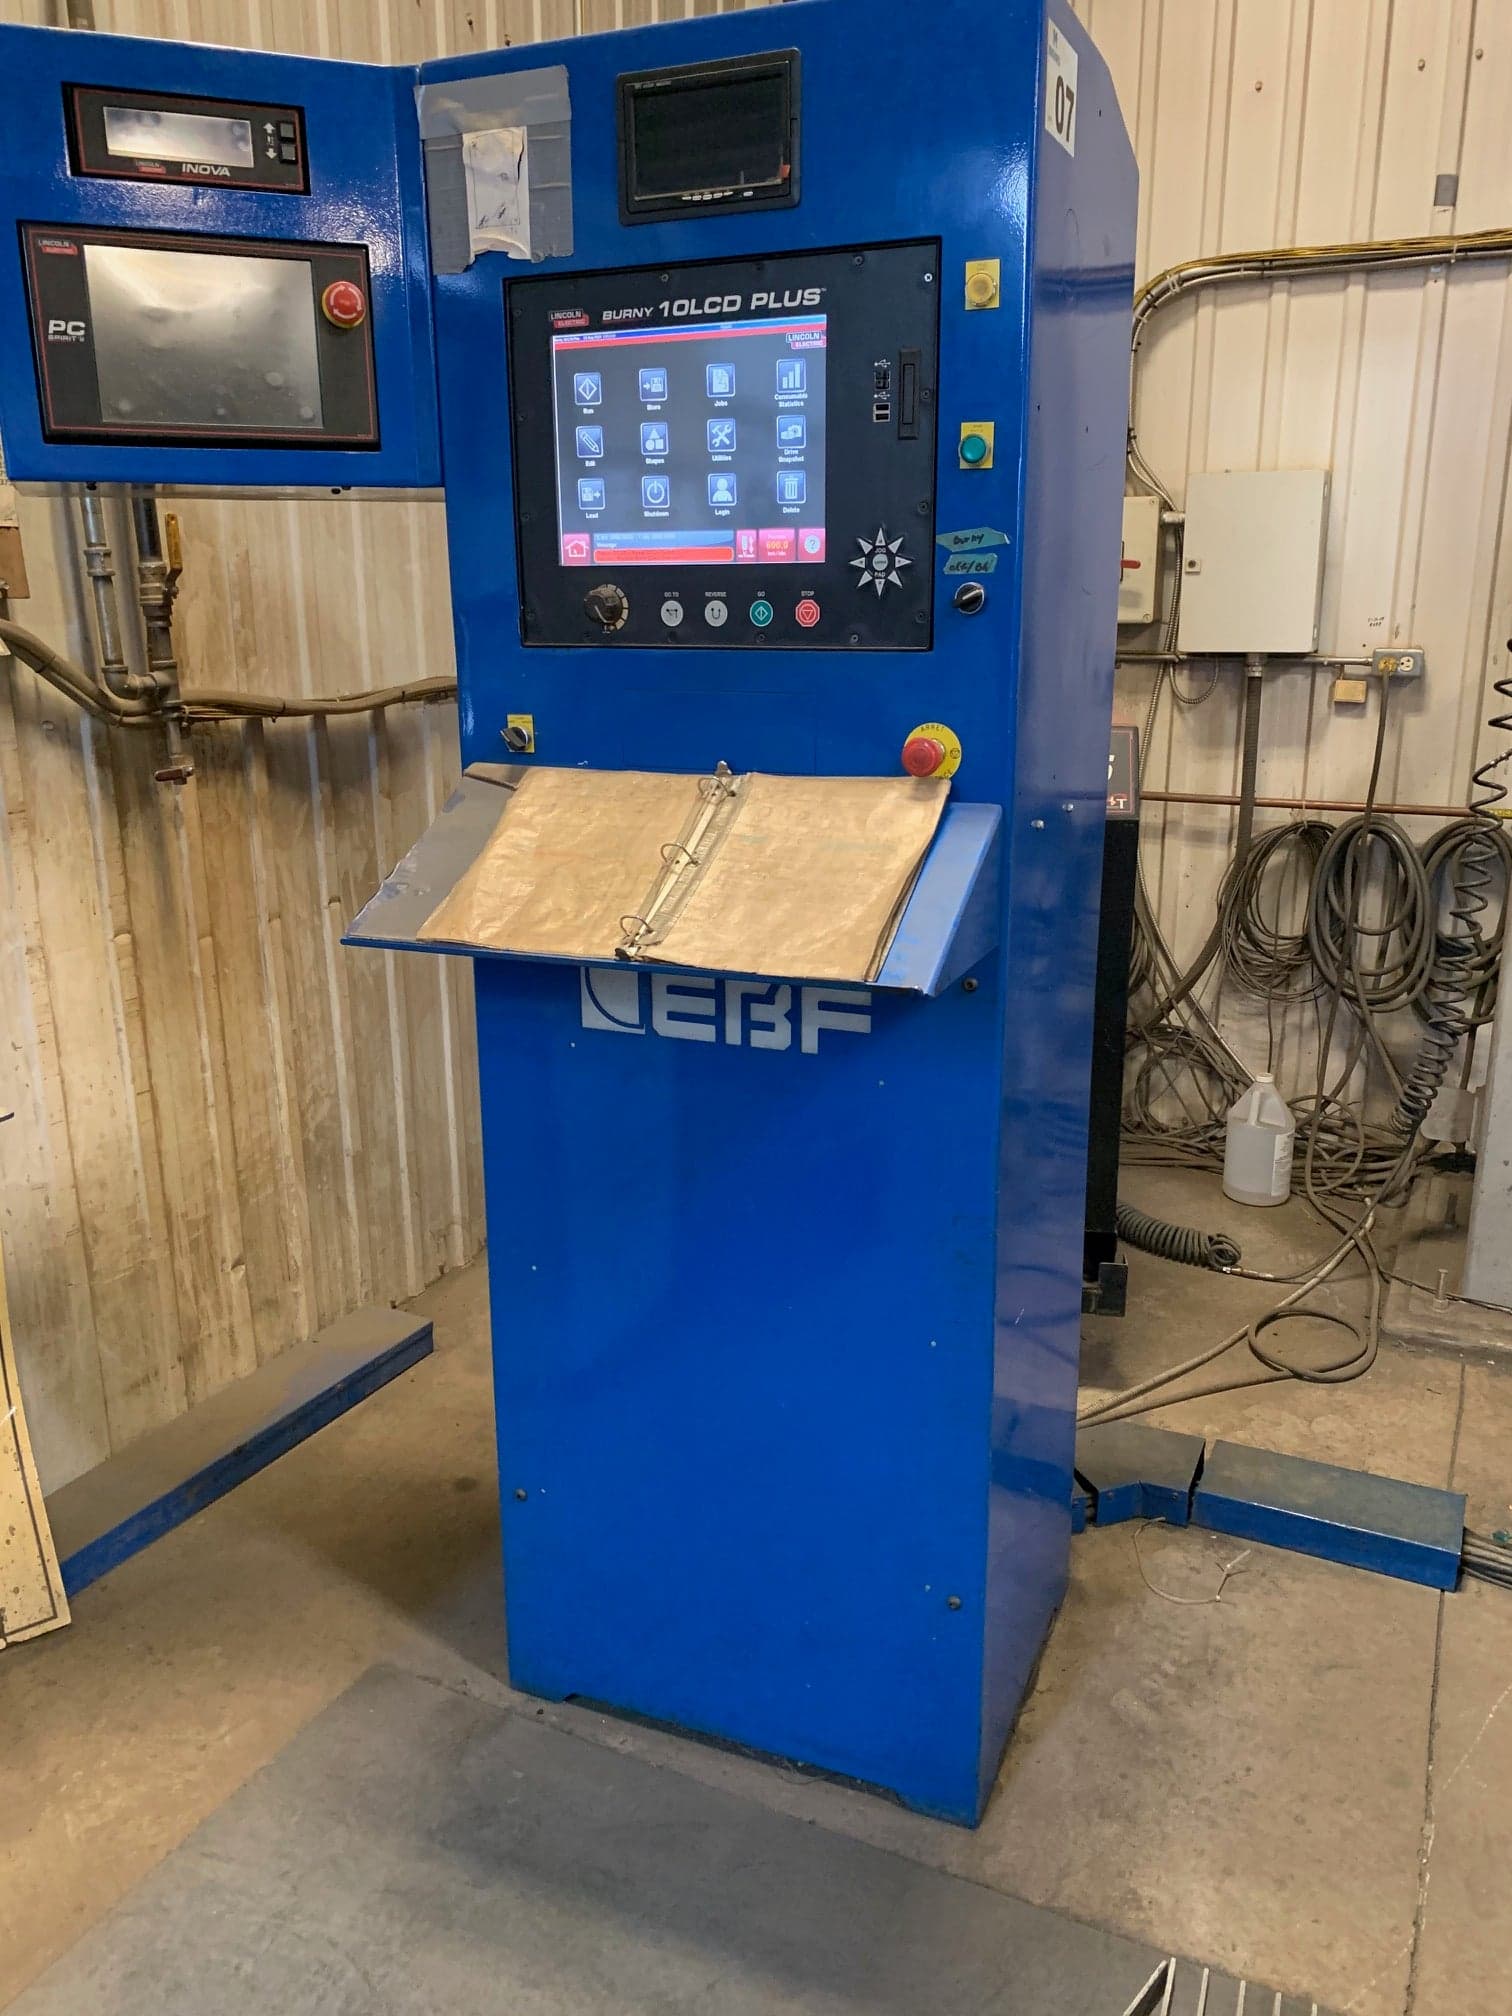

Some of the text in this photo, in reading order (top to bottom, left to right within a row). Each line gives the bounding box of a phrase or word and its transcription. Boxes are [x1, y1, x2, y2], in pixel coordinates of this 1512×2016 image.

[1055, 75, 1075, 143] 07
[181, 162, 231, 177] INOVA
[602, 288, 821, 321] BURNY 10LCD PLUS
[550, 310, 583, 320] LINCOLN
[48, 319, 86, 336] PC
[788, 331, 820, 341] LINCOLN
